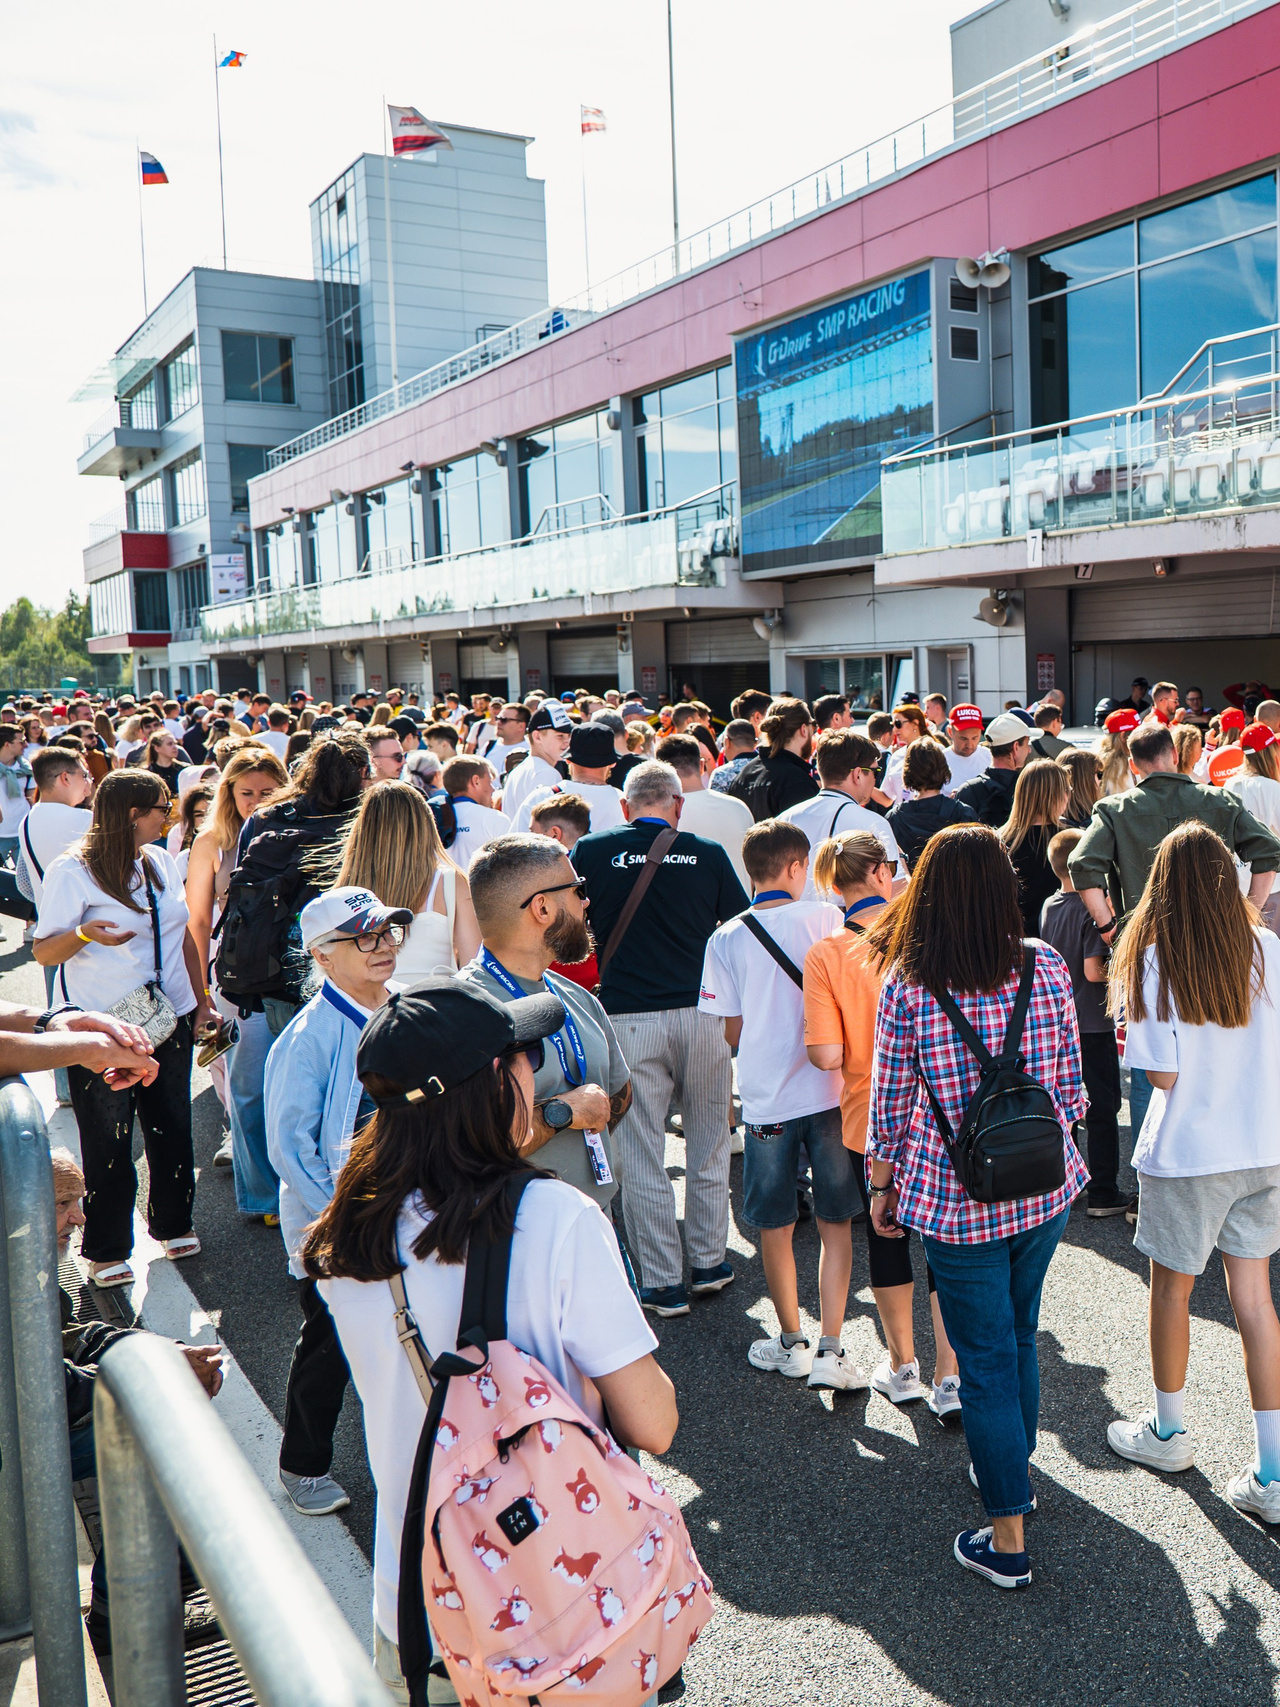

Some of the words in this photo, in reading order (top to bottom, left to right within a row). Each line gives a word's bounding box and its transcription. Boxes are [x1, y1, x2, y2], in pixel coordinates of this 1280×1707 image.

[816, 309, 845, 343] SMP
[847, 279, 906, 330] RACING
[1031, 535, 1038, 562] 7
[1082, 564, 1089, 577] 7
[627, 854, 648, 864] SM
[662, 854, 698, 865] ACING
[490, 965, 502, 978] SMP
[500, 973, 516, 992] RACING
